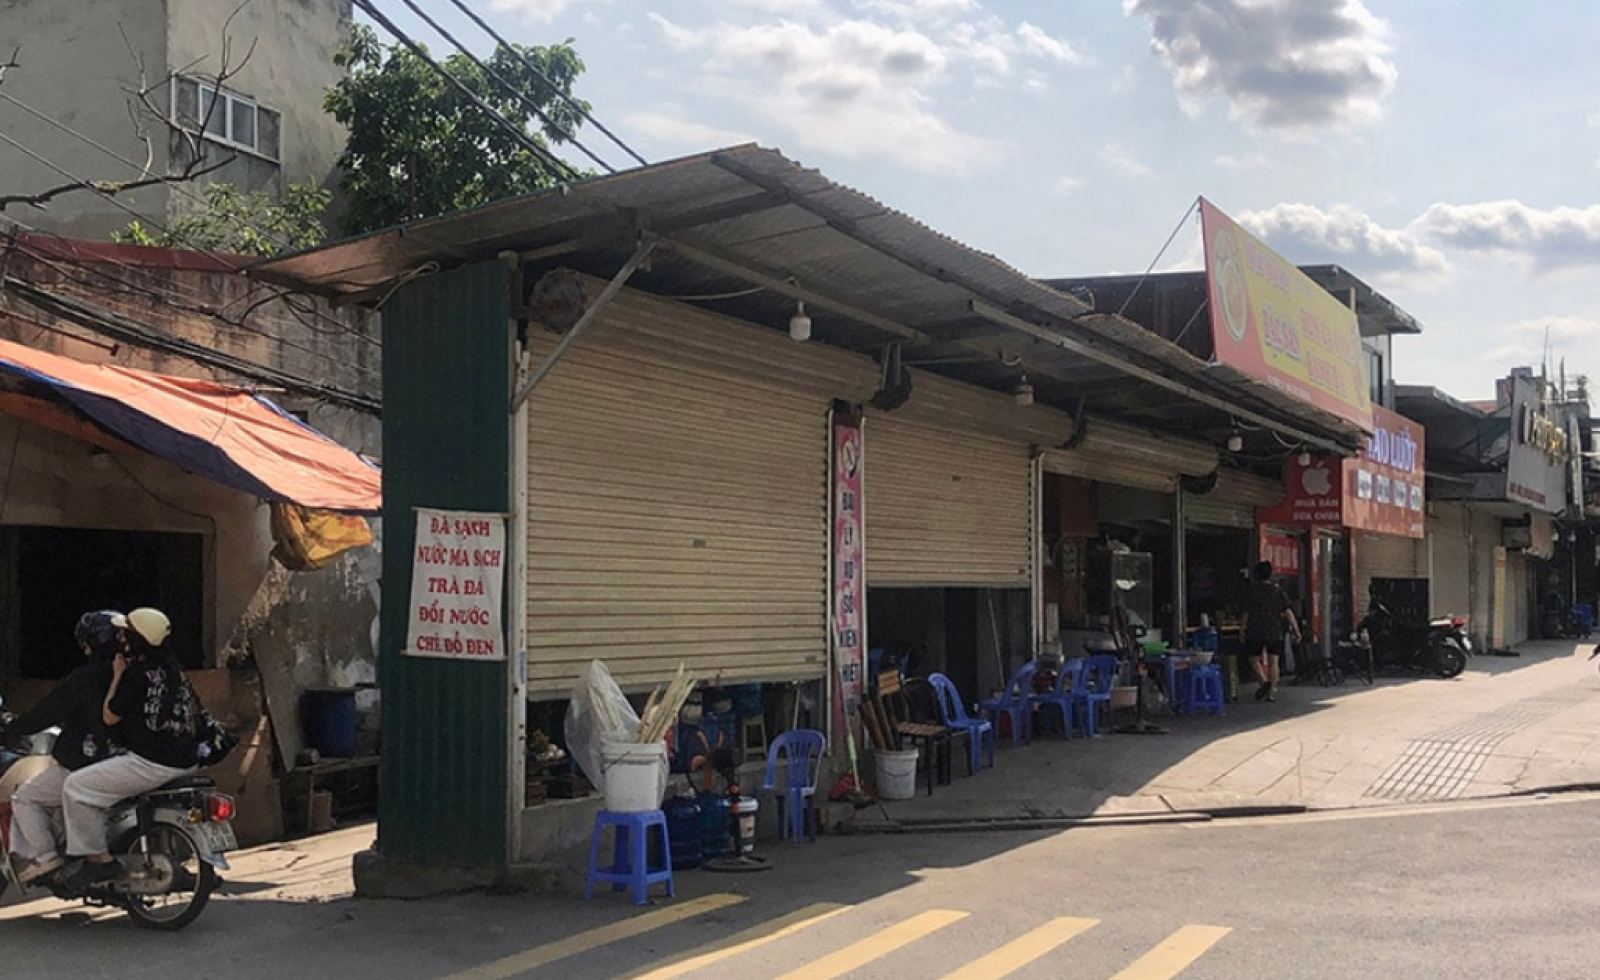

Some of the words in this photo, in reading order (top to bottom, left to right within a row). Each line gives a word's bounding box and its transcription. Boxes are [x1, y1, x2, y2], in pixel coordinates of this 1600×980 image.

[455, 519, 490, 540] SẠCH
[428, 574, 459, 595] TRÀ
[464, 577, 485, 596] ĐÁ
[450, 603, 490, 626] NƯỚC
[465, 637, 495, 656] ĐEN
